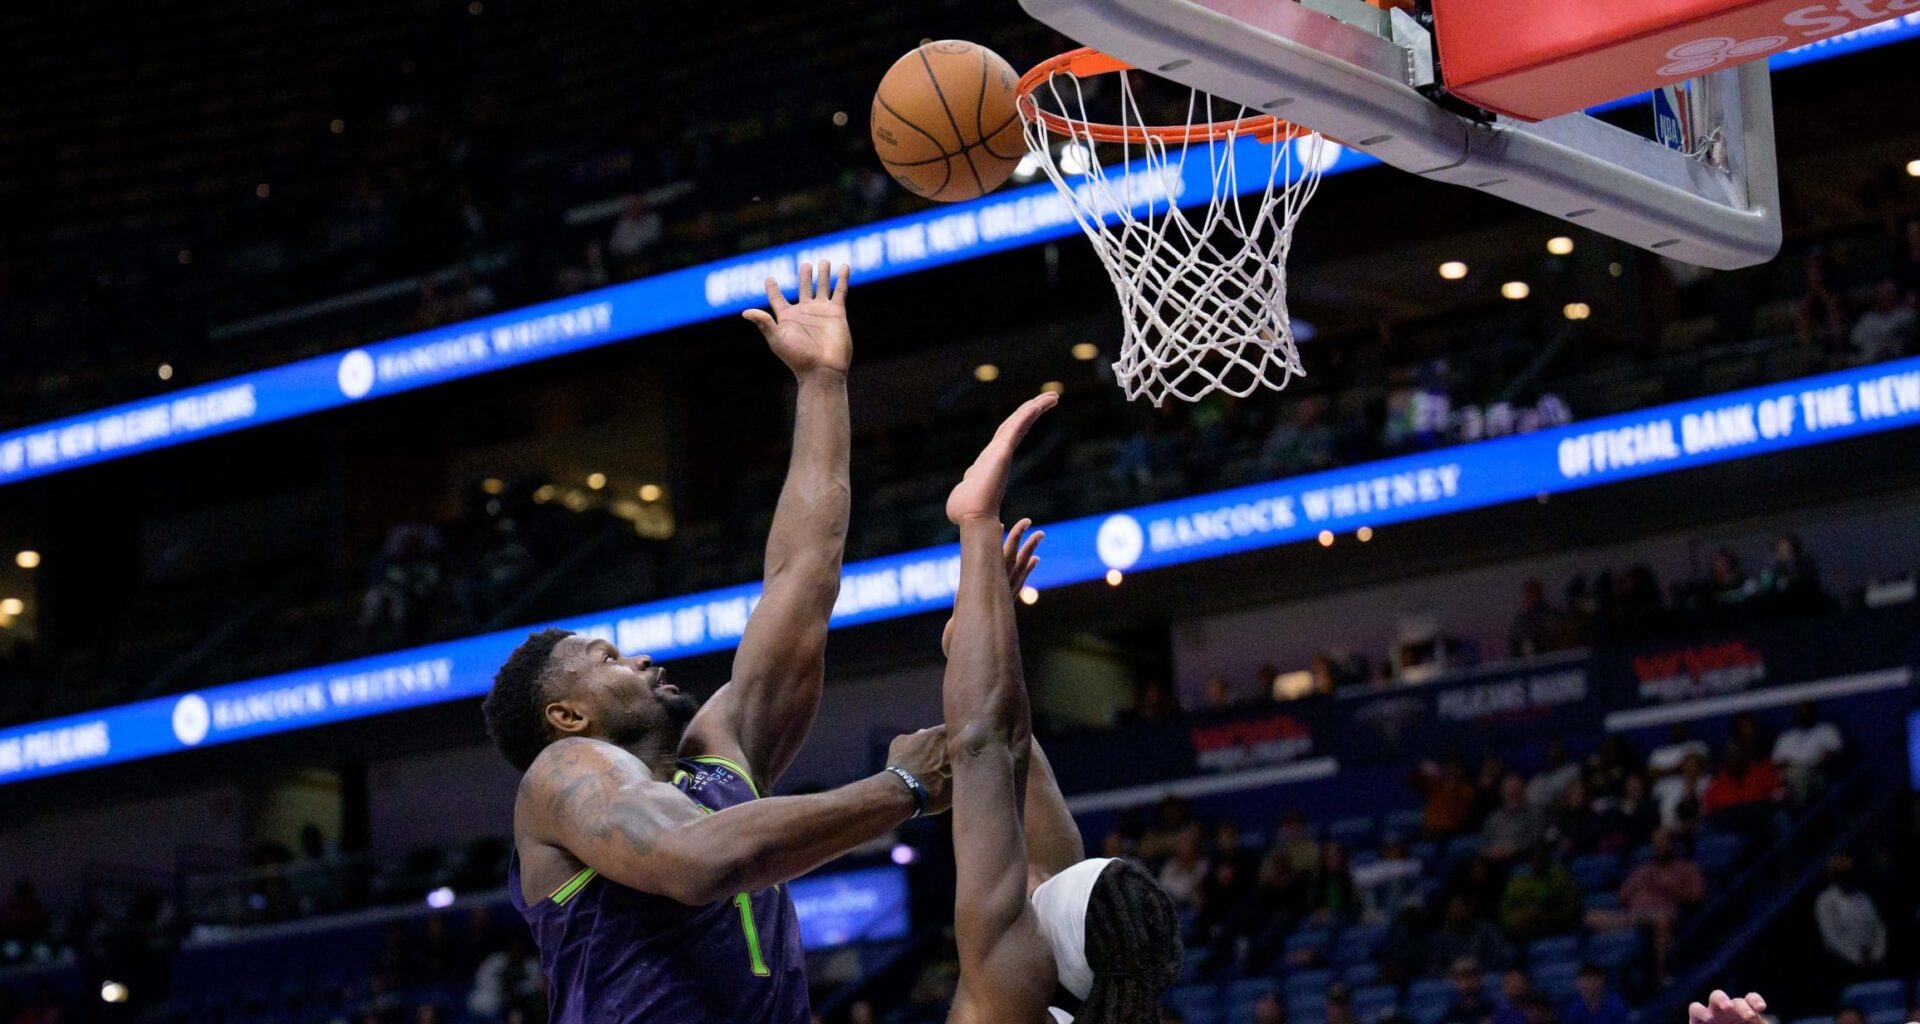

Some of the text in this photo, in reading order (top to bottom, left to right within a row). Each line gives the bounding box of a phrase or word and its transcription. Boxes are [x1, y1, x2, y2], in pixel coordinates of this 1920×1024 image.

[1659, 113, 1679, 144] NBA
[886, 222, 926, 264] THE
[377, 301, 613, 382] HANCOCK WHITNEY
[1557, 370, 1920, 478] OFFICIAL BANK OF THE NEW
[1148, 463, 1463, 554] HANCOCK WHITNEY
[616, 611, 673, 657] BANK
[674, 605, 705, 645] OF
[707, 596, 748, 640] THE
[213, 657, 454, 730] HANCOCK WHITNEY
[733, 890, 770, 976] 1
